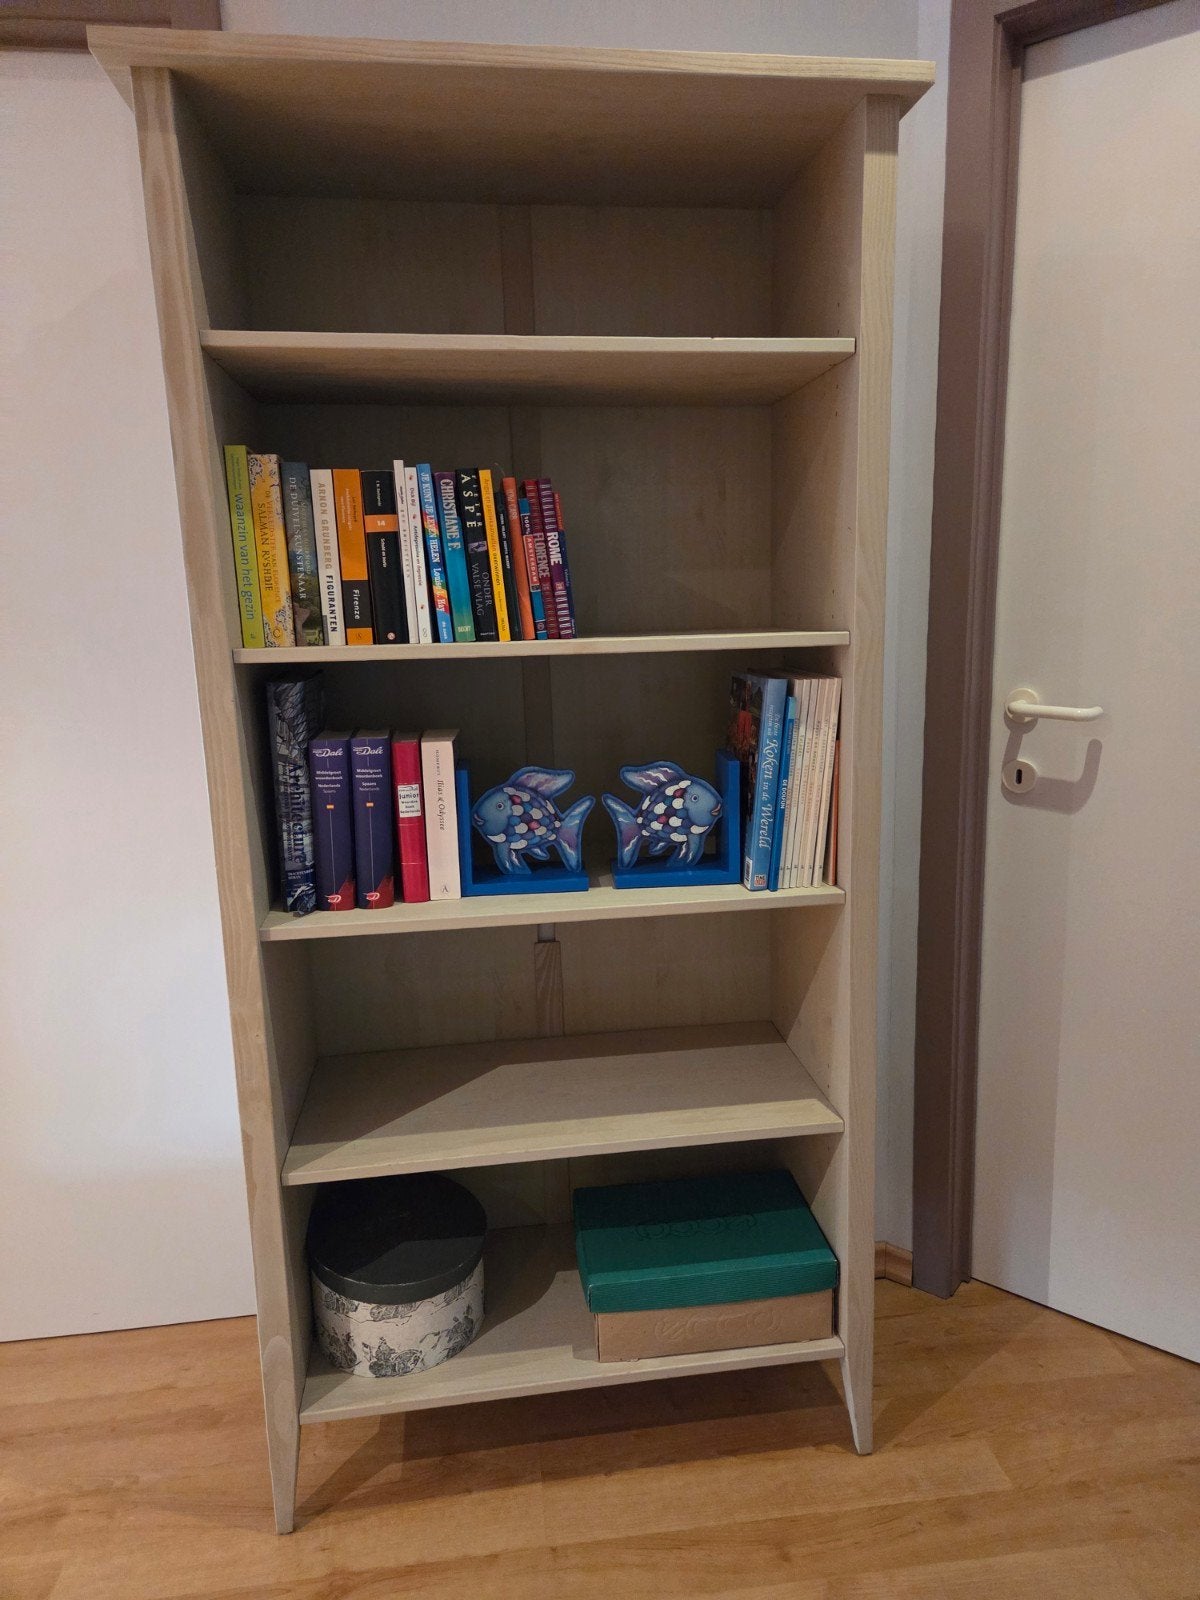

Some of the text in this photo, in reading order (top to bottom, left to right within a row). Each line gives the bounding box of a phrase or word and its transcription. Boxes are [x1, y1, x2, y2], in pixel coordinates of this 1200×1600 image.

[235, 493, 247, 542] waanzin
[421, 473, 441, 562] JE KUNT JE LEVEN HELEN
[440, 479, 461, 551] CHRISTIANE F.
[461, 474, 477, 528] ASPE
[258, 503, 270, 545] SALMAN
[289, 477, 307, 599] DE DUIVELSKUNSTENAAR
[240, 545, 249, 564] van
[318, 483, 338, 632] ARNON GRUNBERG FIGURANTEN
[527, 538, 538, 581] AMSTERDAM
[533, 532, 551, 578] FLORENCE
[547, 531, 562, 566] ROME
[242, 569, 253, 587] het
[433, 568, 442, 588] Louise
[472, 563, 485, 616] VALSE VLAG
[482, 572, 493, 606] ONDER
[241, 591, 254, 620] gezin
[436, 599, 446, 612] Hay
[289, 762, 306, 864] Architecture
[759, 739, 779, 850] Koken in de Wereld
[437, 803, 446, 831] Odyssee
